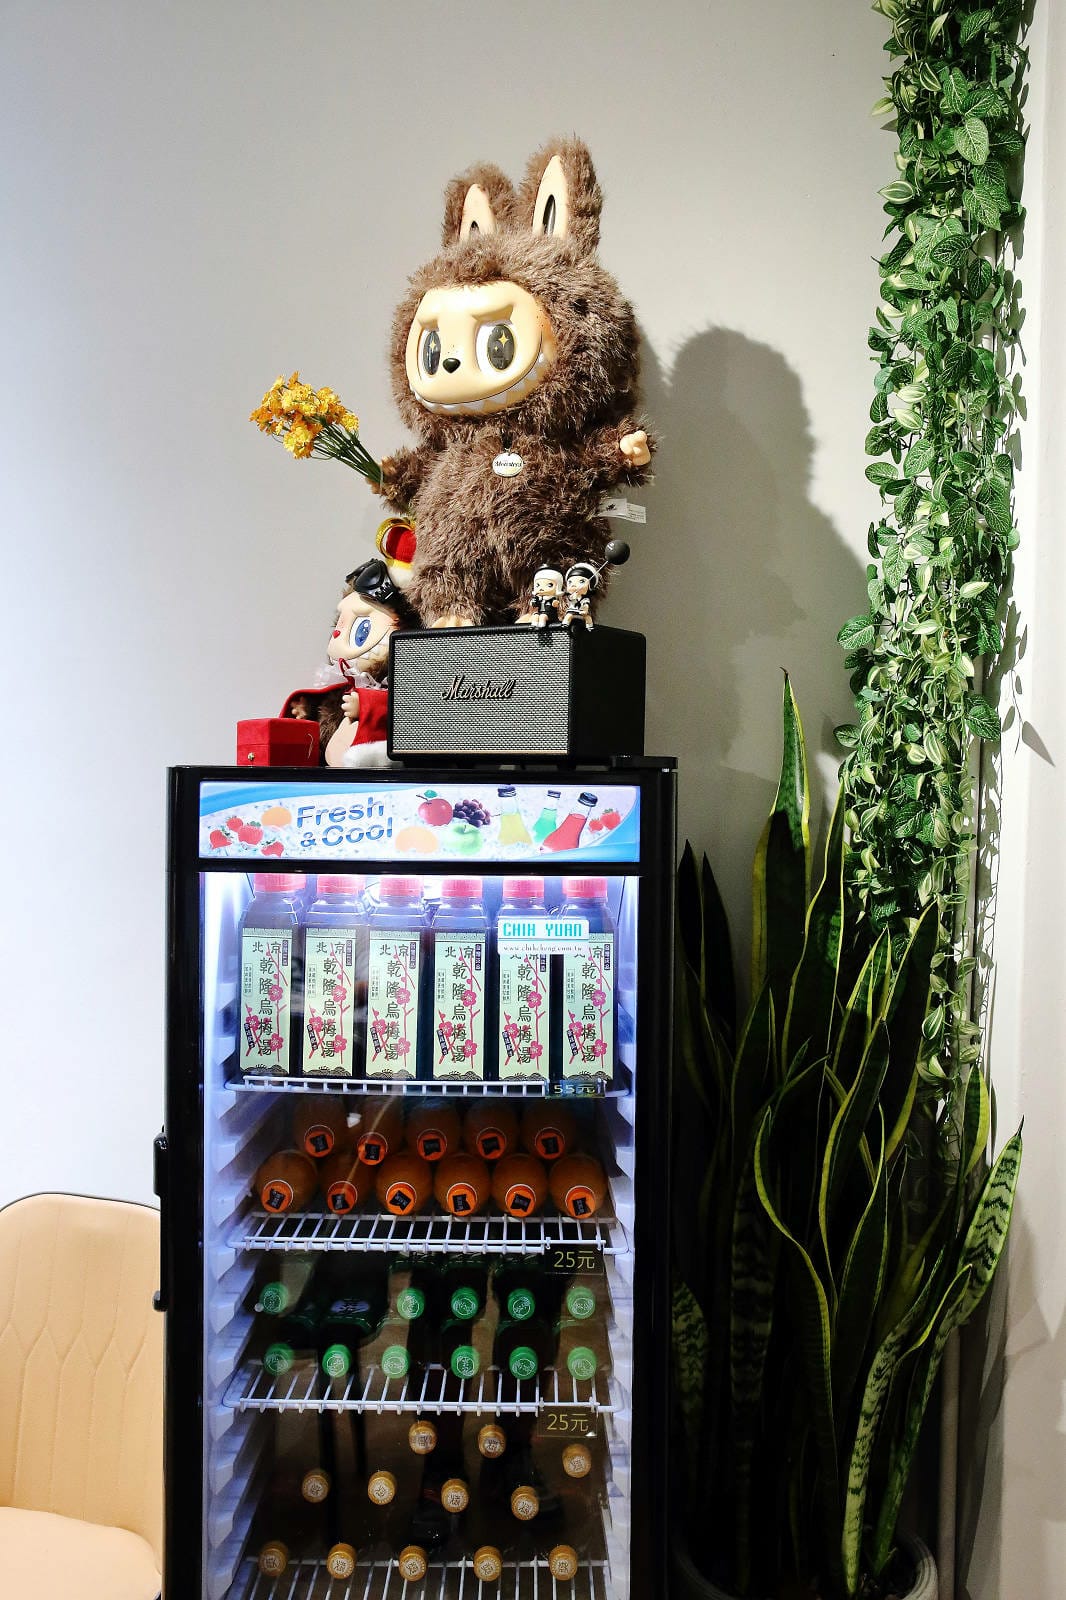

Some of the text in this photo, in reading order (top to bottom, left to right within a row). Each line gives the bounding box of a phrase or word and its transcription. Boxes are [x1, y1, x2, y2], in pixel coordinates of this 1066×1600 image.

[441, 674, 516, 701] Marshall
[296, 796, 384, 829] Fresh
[300, 818, 393, 848] & Cool
[503, 923, 582, 937] CHIH YUAN
[554, 1084, 596, 1095] 55元
[553, 1251, 596, 1270] 25元
[546, 1413, 589, 1433] 25元
